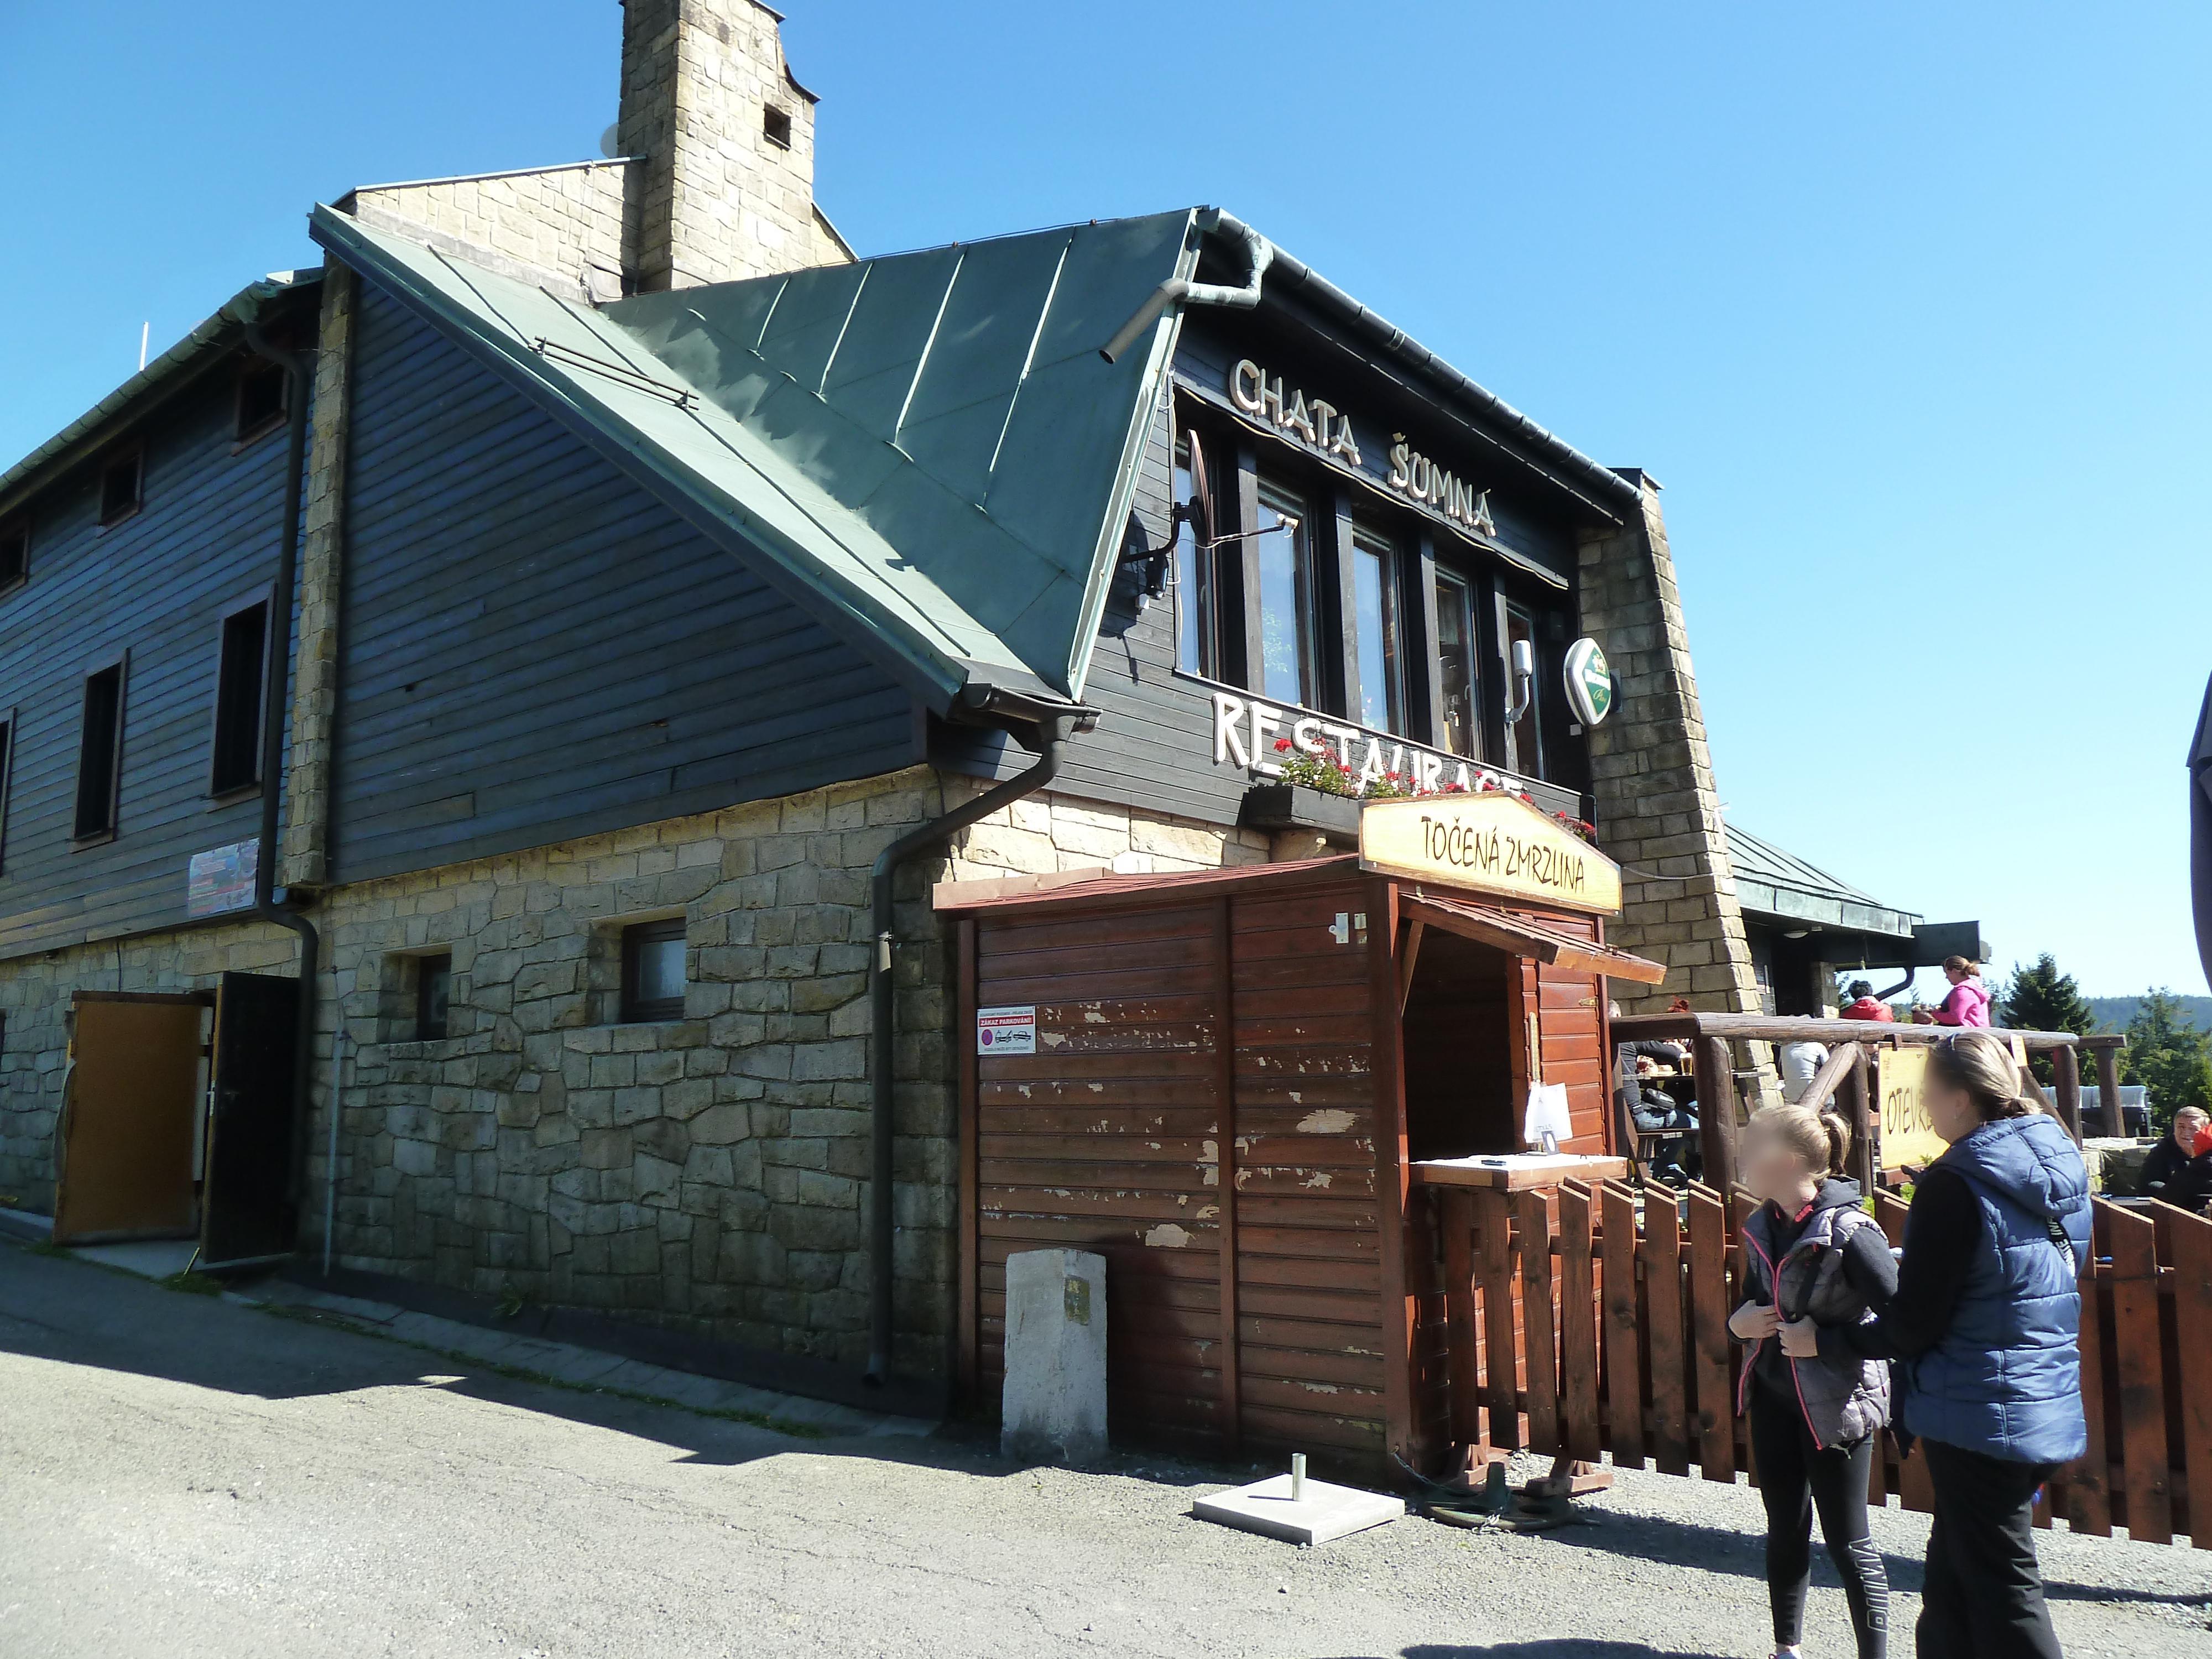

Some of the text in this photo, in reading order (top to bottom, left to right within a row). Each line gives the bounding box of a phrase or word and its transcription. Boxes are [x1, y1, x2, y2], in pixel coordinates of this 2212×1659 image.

[1229, 359, 1497, 537] CHATA ŠUMNÁ
[1421, 816, 1585, 893] TOČENÁ ZMRZLINA
